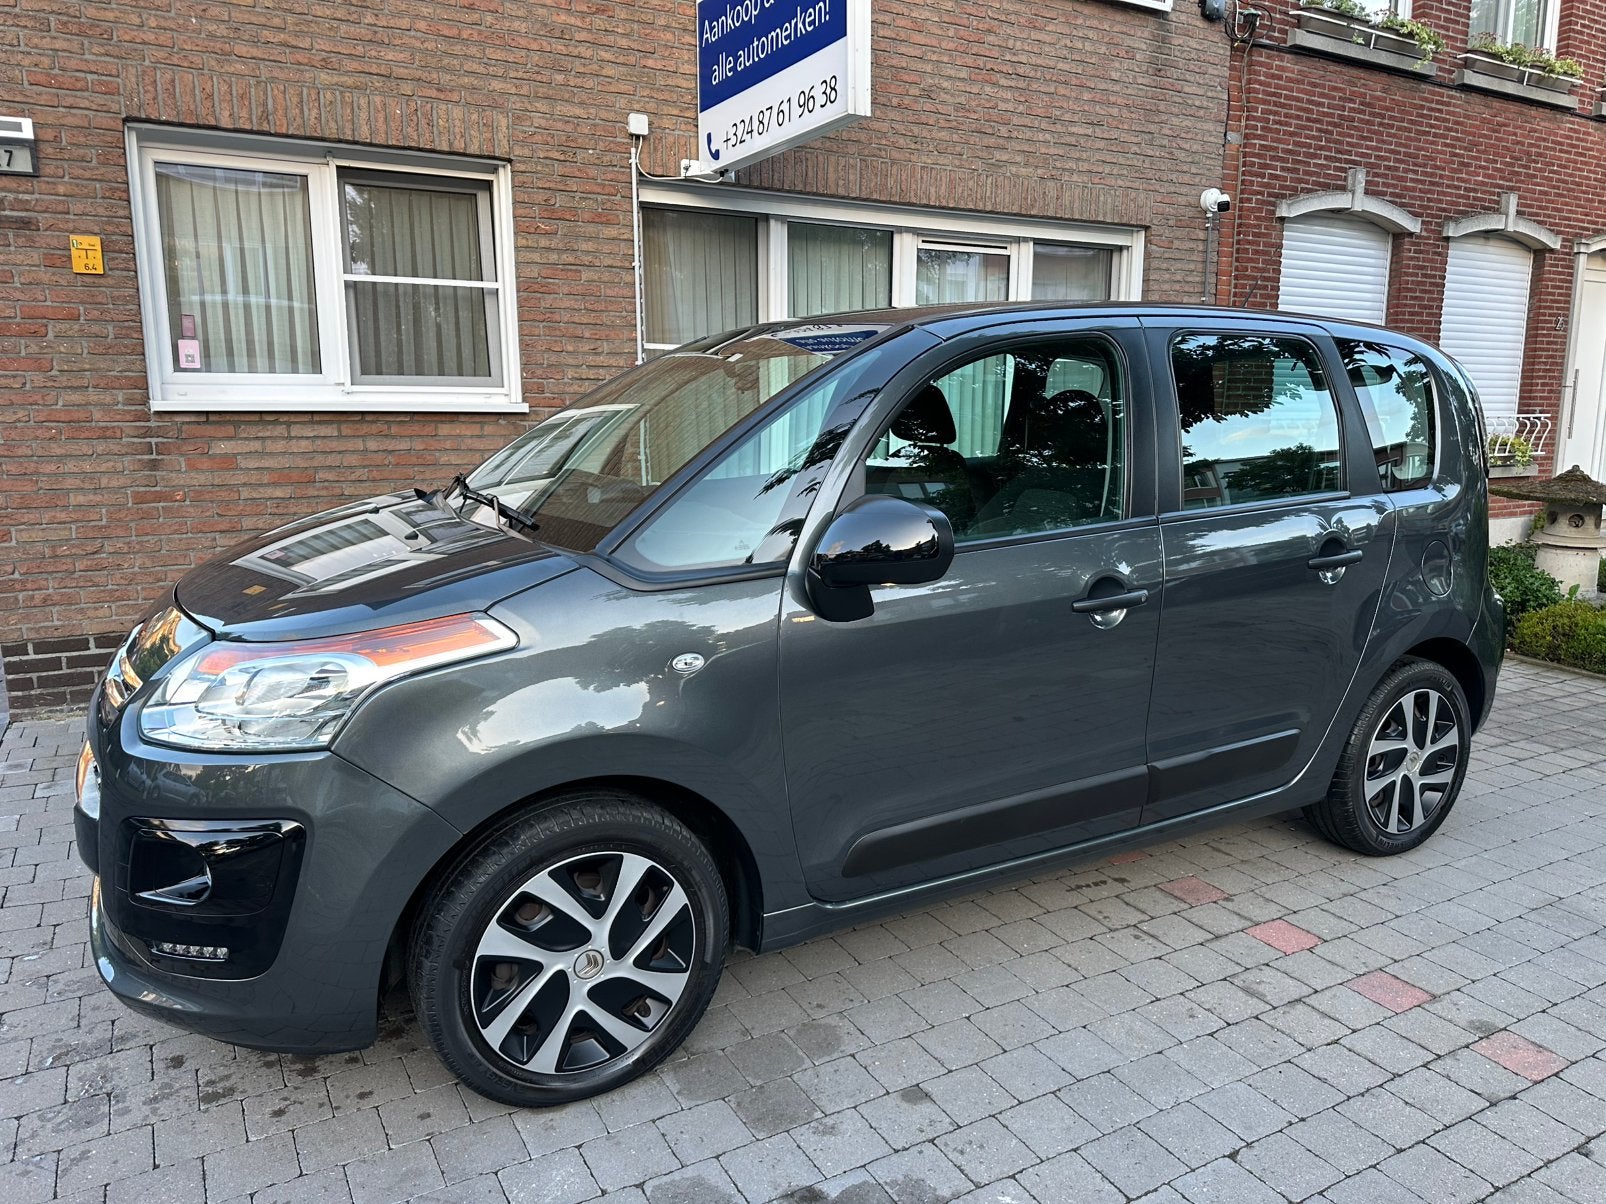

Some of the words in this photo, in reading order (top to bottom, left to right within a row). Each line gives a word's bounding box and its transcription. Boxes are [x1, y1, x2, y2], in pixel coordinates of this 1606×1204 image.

[702, 0, 761, 47] Aankoop
[711, 52, 734, 86] alle
[736, 0, 830, 72] automerken!
[722, 115, 754, 150] +324
[757, 106, 773, 136] 87
[776, 96, 792, 127] 61
[798, 85, 816, 119] 96
[819, 75, 838, 109] 38
[0, 149, 13, 168] 7
